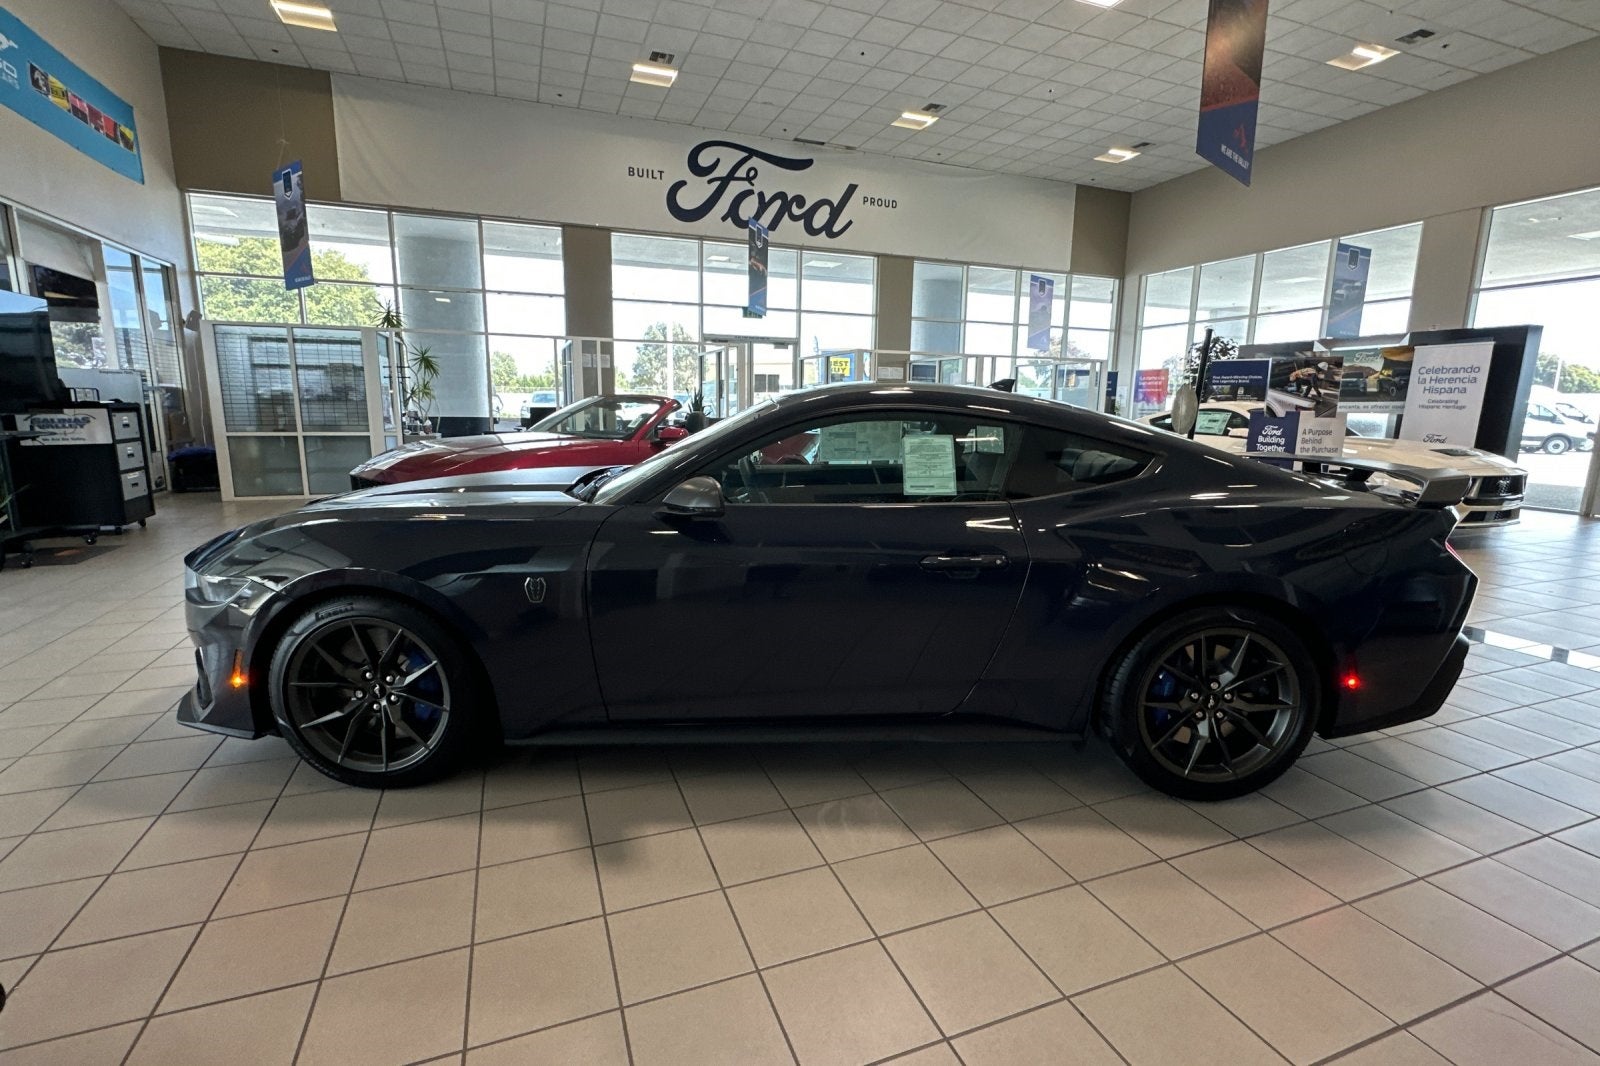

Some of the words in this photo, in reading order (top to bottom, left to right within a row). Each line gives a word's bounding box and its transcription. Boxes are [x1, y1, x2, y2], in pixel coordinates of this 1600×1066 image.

[628, 166, 665, 181] BUILT
[666, 140, 858, 239] Ford
[863, 196, 898, 209] PROUD
[1353, 351, 1382, 362] Ford
[1418, 364, 1481, 375] Celebrando
[1417, 376, 1427, 385] la
[1428, 375, 1478, 384] Herencia
[1422, 386, 1468, 396] Hispana
[1262, 424, 1284, 436] Ford
[1302, 428, 1307, 436] A
[1308, 428, 1333, 436] Purpose
[1257, 435, 1286, 445] Building
[1301, 437, 1323, 445] Behind
[1422, 433, 1448, 444] Ford
[1256, 444, 1286, 453] Together
[1300, 446, 1310, 454] the
[1311, 446, 1339, 454] Purchase
